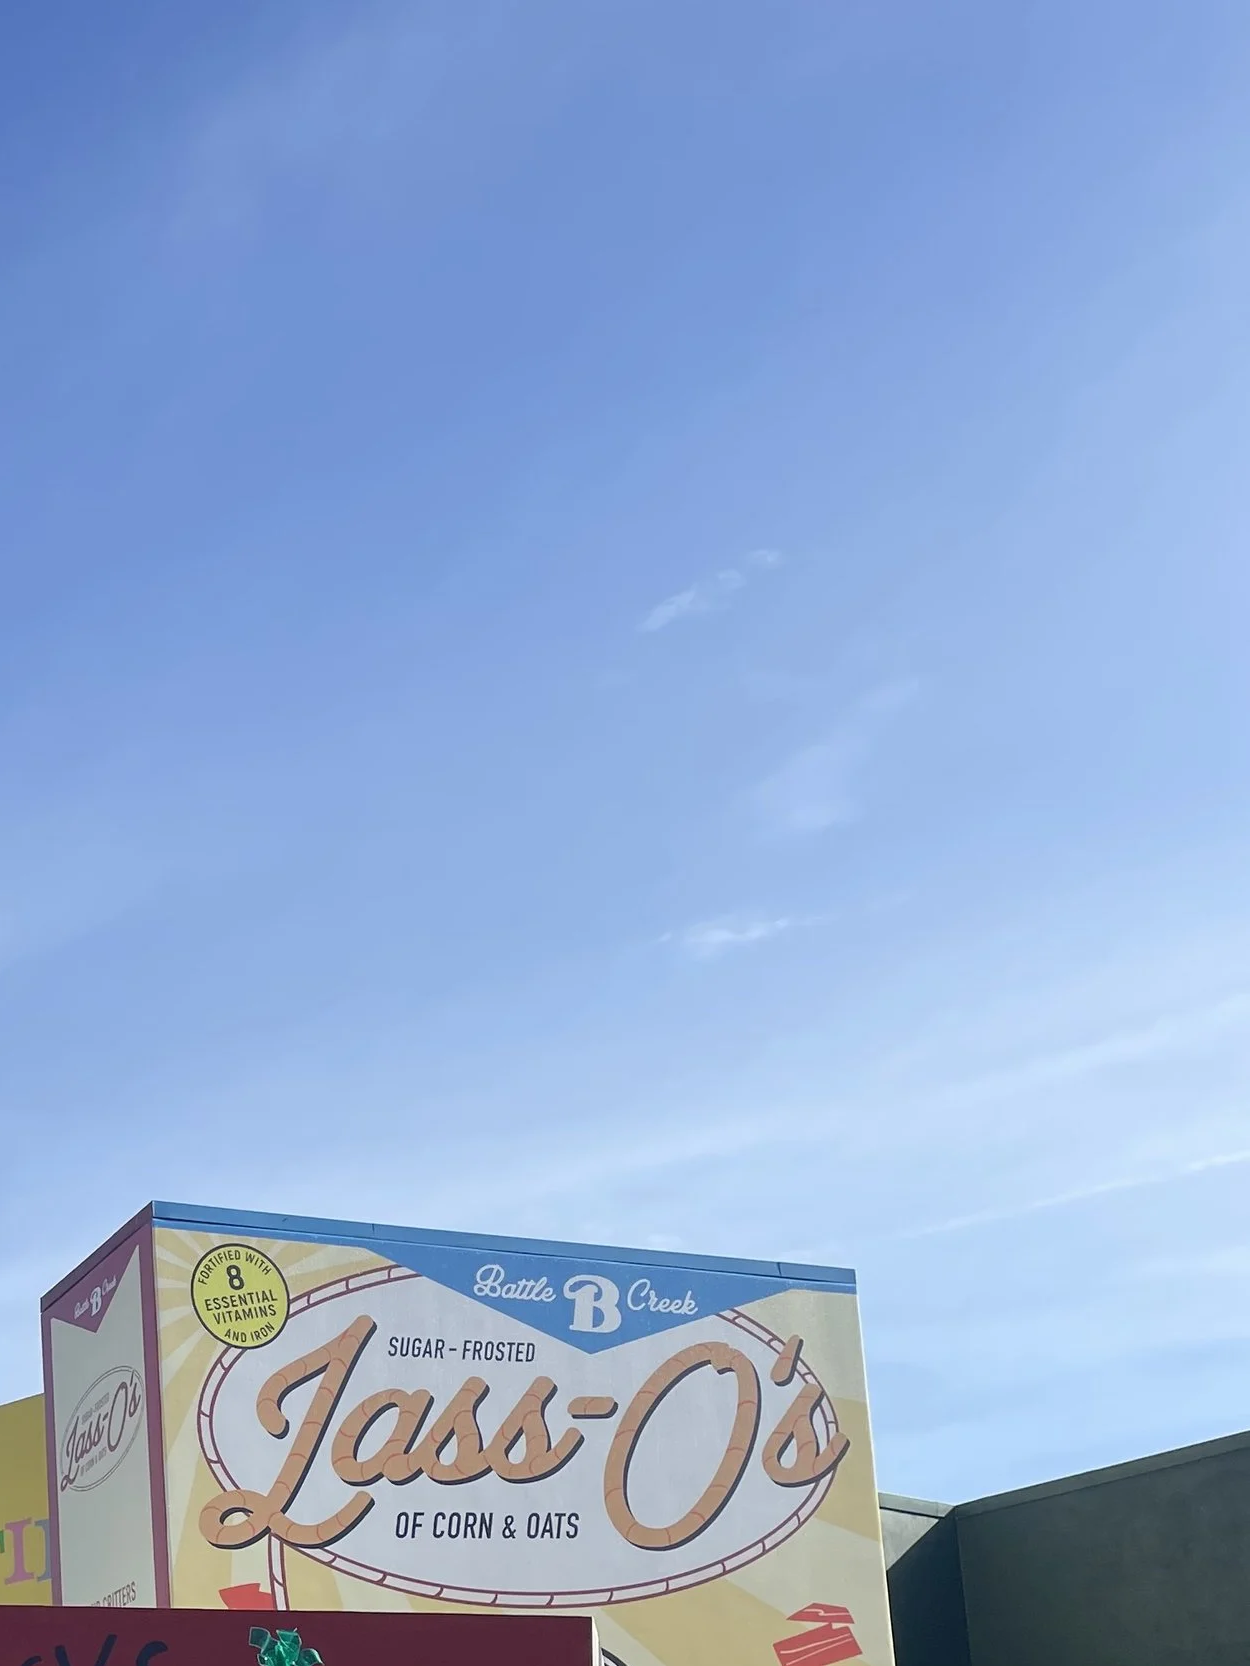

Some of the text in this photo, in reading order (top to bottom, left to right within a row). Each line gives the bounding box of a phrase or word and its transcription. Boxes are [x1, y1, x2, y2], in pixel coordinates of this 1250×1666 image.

[198, 1250, 272, 1285] FORTIFIED WITH
[226, 1264, 245, 1290] 8
[205, 1289, 278, 1311] ESSENTIAL
[473, 1264, 698, 1333] Battle B Creek
[213, 1304, 277, 1325] VITAMINS
[224, 1322, 275, 1343] AND IRON
[395, 1511, 580, 1539] OF CORN & OATS
